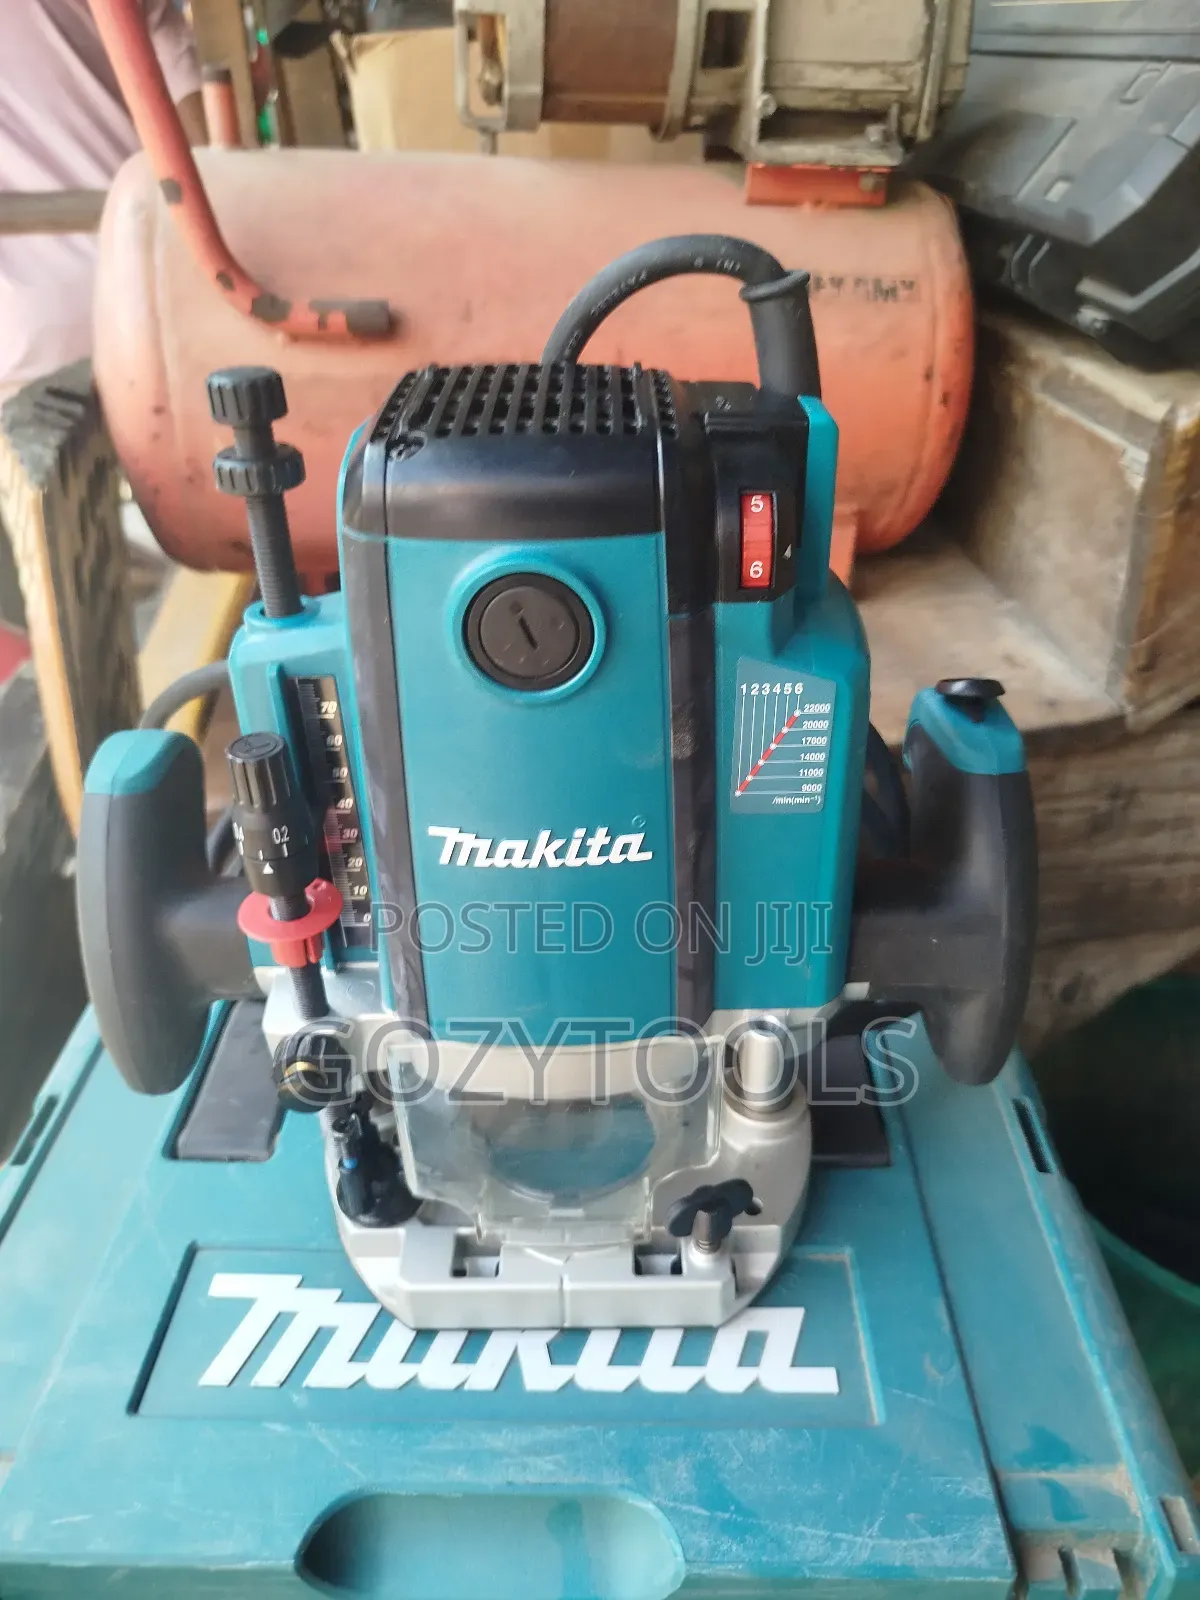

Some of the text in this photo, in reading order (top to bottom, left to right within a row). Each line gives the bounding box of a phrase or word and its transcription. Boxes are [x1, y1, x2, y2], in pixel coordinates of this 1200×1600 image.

[750, 495, 764, 513] 5
[749, 560, 764, 578] 6
[320, 701, 338, 714] 70
[803, 703, 831, 713] 22000
[802, 720, 829, 729] 20000
[801, 736, 827, 745] 17000
[800, 752, 826, 761] 14000
[798, 768, 824, 777] 11000
[801, 784, 823, 792] 9000
[336, 798, 354, 809] 40
[347, 857, 363, 868] 20
[353, 885, 368, 895] 10
[363, 912, 372, 923] 0
